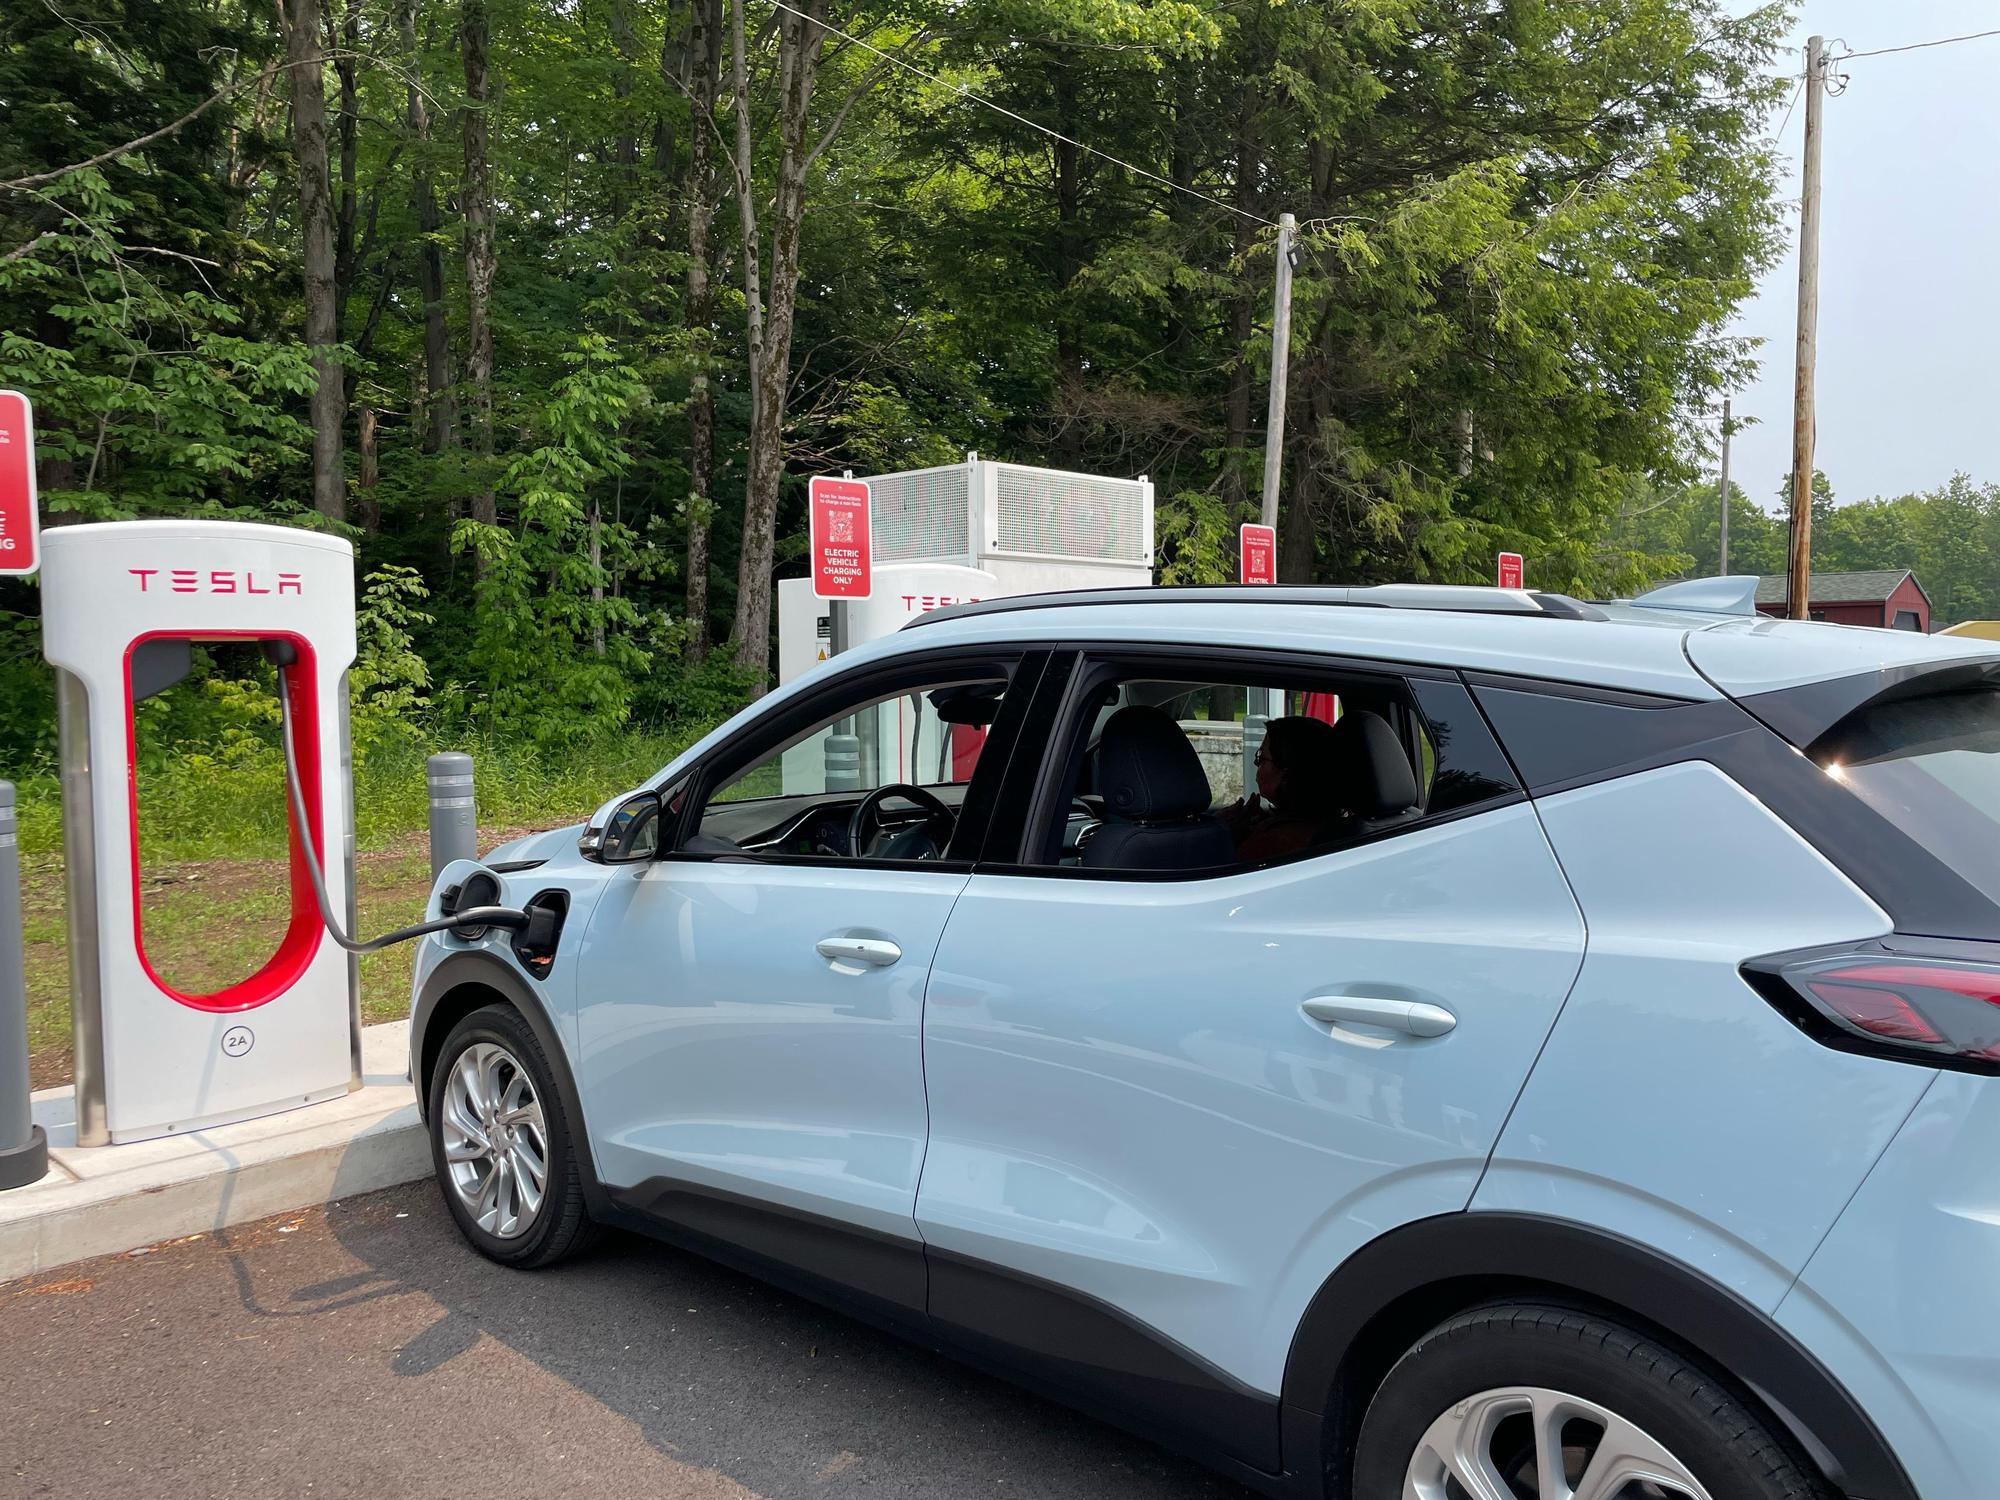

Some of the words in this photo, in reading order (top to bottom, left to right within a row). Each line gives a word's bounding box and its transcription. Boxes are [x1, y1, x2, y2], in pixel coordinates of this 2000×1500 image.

[824, 548, 860, 557] ELECTRIC
[827, 557, 858, 566] VEHICLE
[823, 567, 862, 576] CHARGING
[128, 569, 302, 595] TESLA
[833, 576, 853, 584] ONLY
[229, 1036, 247, 1047] 2A
